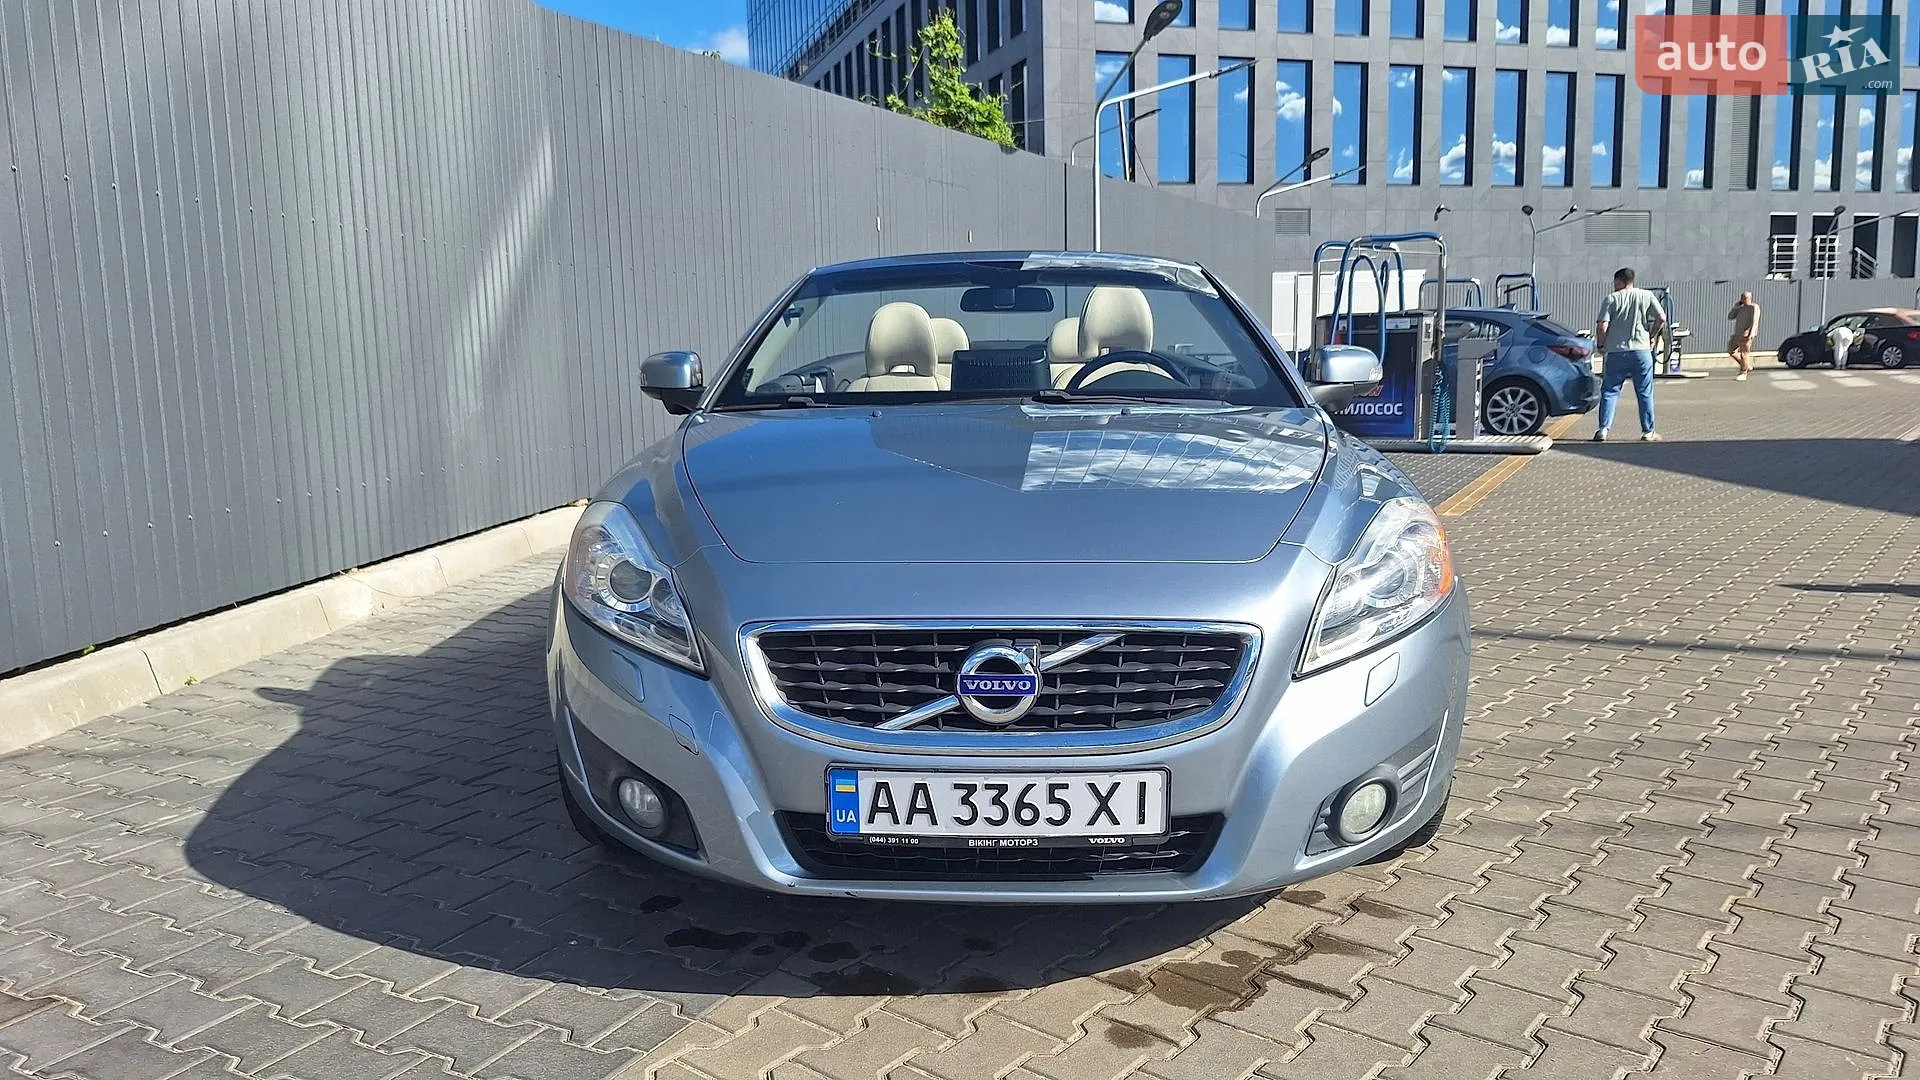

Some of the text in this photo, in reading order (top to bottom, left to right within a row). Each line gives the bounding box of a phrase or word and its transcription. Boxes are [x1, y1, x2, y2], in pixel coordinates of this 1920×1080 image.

[1334, 402, 1403, 416] ИЛОСОС
[963, 679, 1031, 691] VOLVO
[867, 781, 1147, 827] AA 3365 XI
[836, 809, 857, 824] UA
[869, 836, 887, 844] (044)
[968, 838, 1039, 847] ВІКІНГ МОТОРЗ
